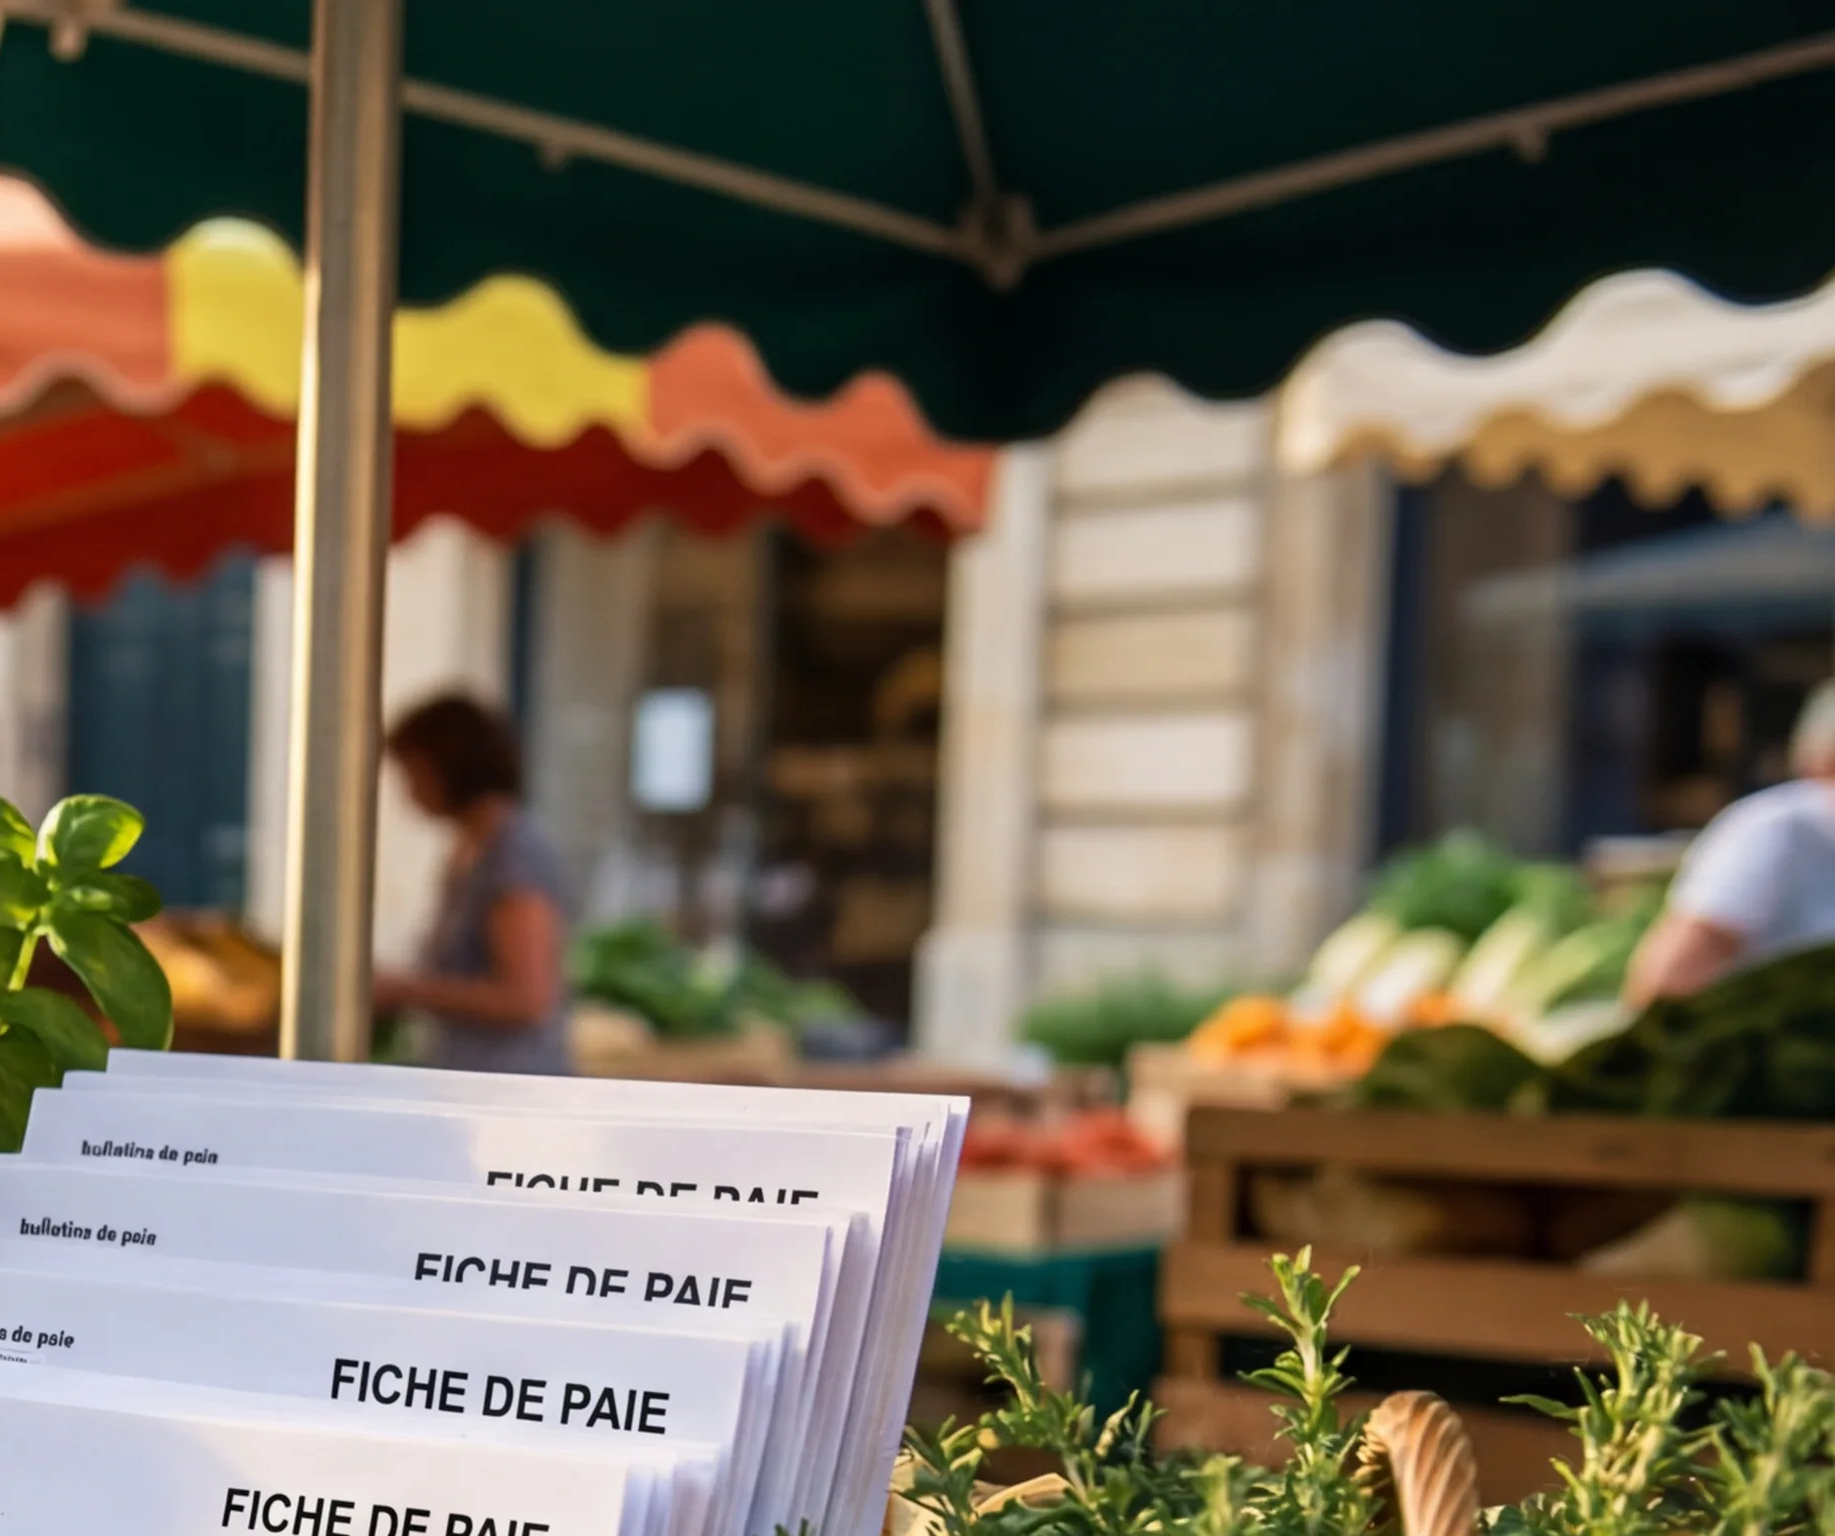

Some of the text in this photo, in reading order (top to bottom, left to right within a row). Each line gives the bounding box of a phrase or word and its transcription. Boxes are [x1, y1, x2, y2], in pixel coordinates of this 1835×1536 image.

[415, 1253, 752, 1308] FICHE DE PAIE
[12, 1326, 32, 1343] de
[331, 1358, 669, 1434] FICHE DE PAIE
